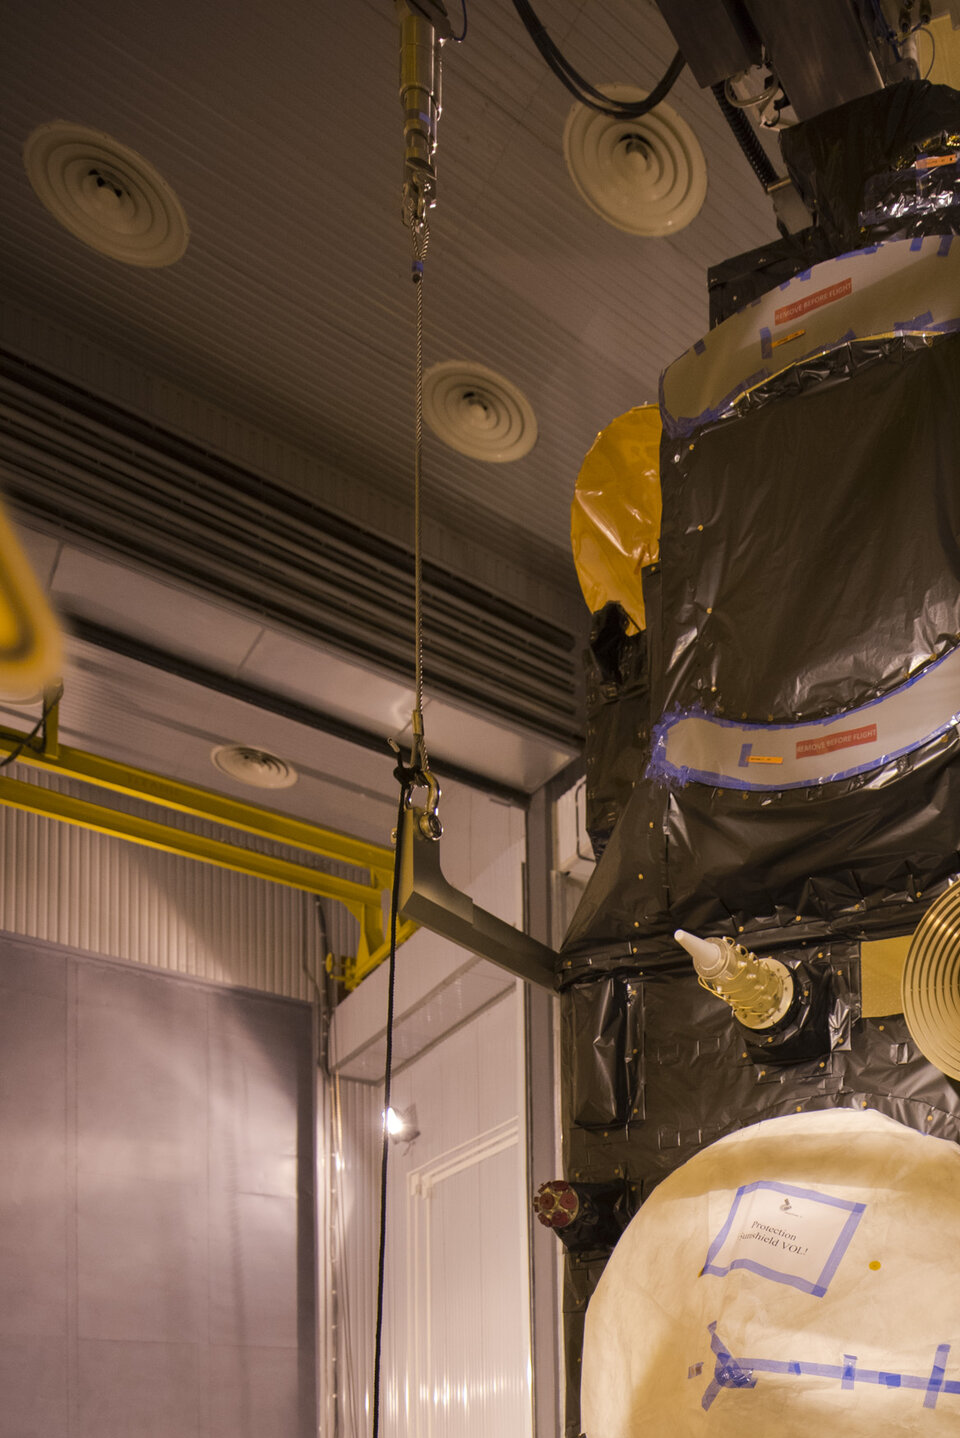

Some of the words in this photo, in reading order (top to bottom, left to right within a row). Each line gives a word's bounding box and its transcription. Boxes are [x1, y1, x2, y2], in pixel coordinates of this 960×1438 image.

[775, 303, 803, 320] REMOVE
[804, 294, 828, 312] BEFORE
[829, 282, 851, 298] FLIGHT
[796, 741, 826, 753] REMOVE
[826, 734, 852, 746] BEFORE
[853, 728, 876, 740] FLIGHT
[751, 1220, 797, 1241] Protection
[737, 1232, 780, 1247] Sunshield
[782, 1241, 808, 1255] VOL!
